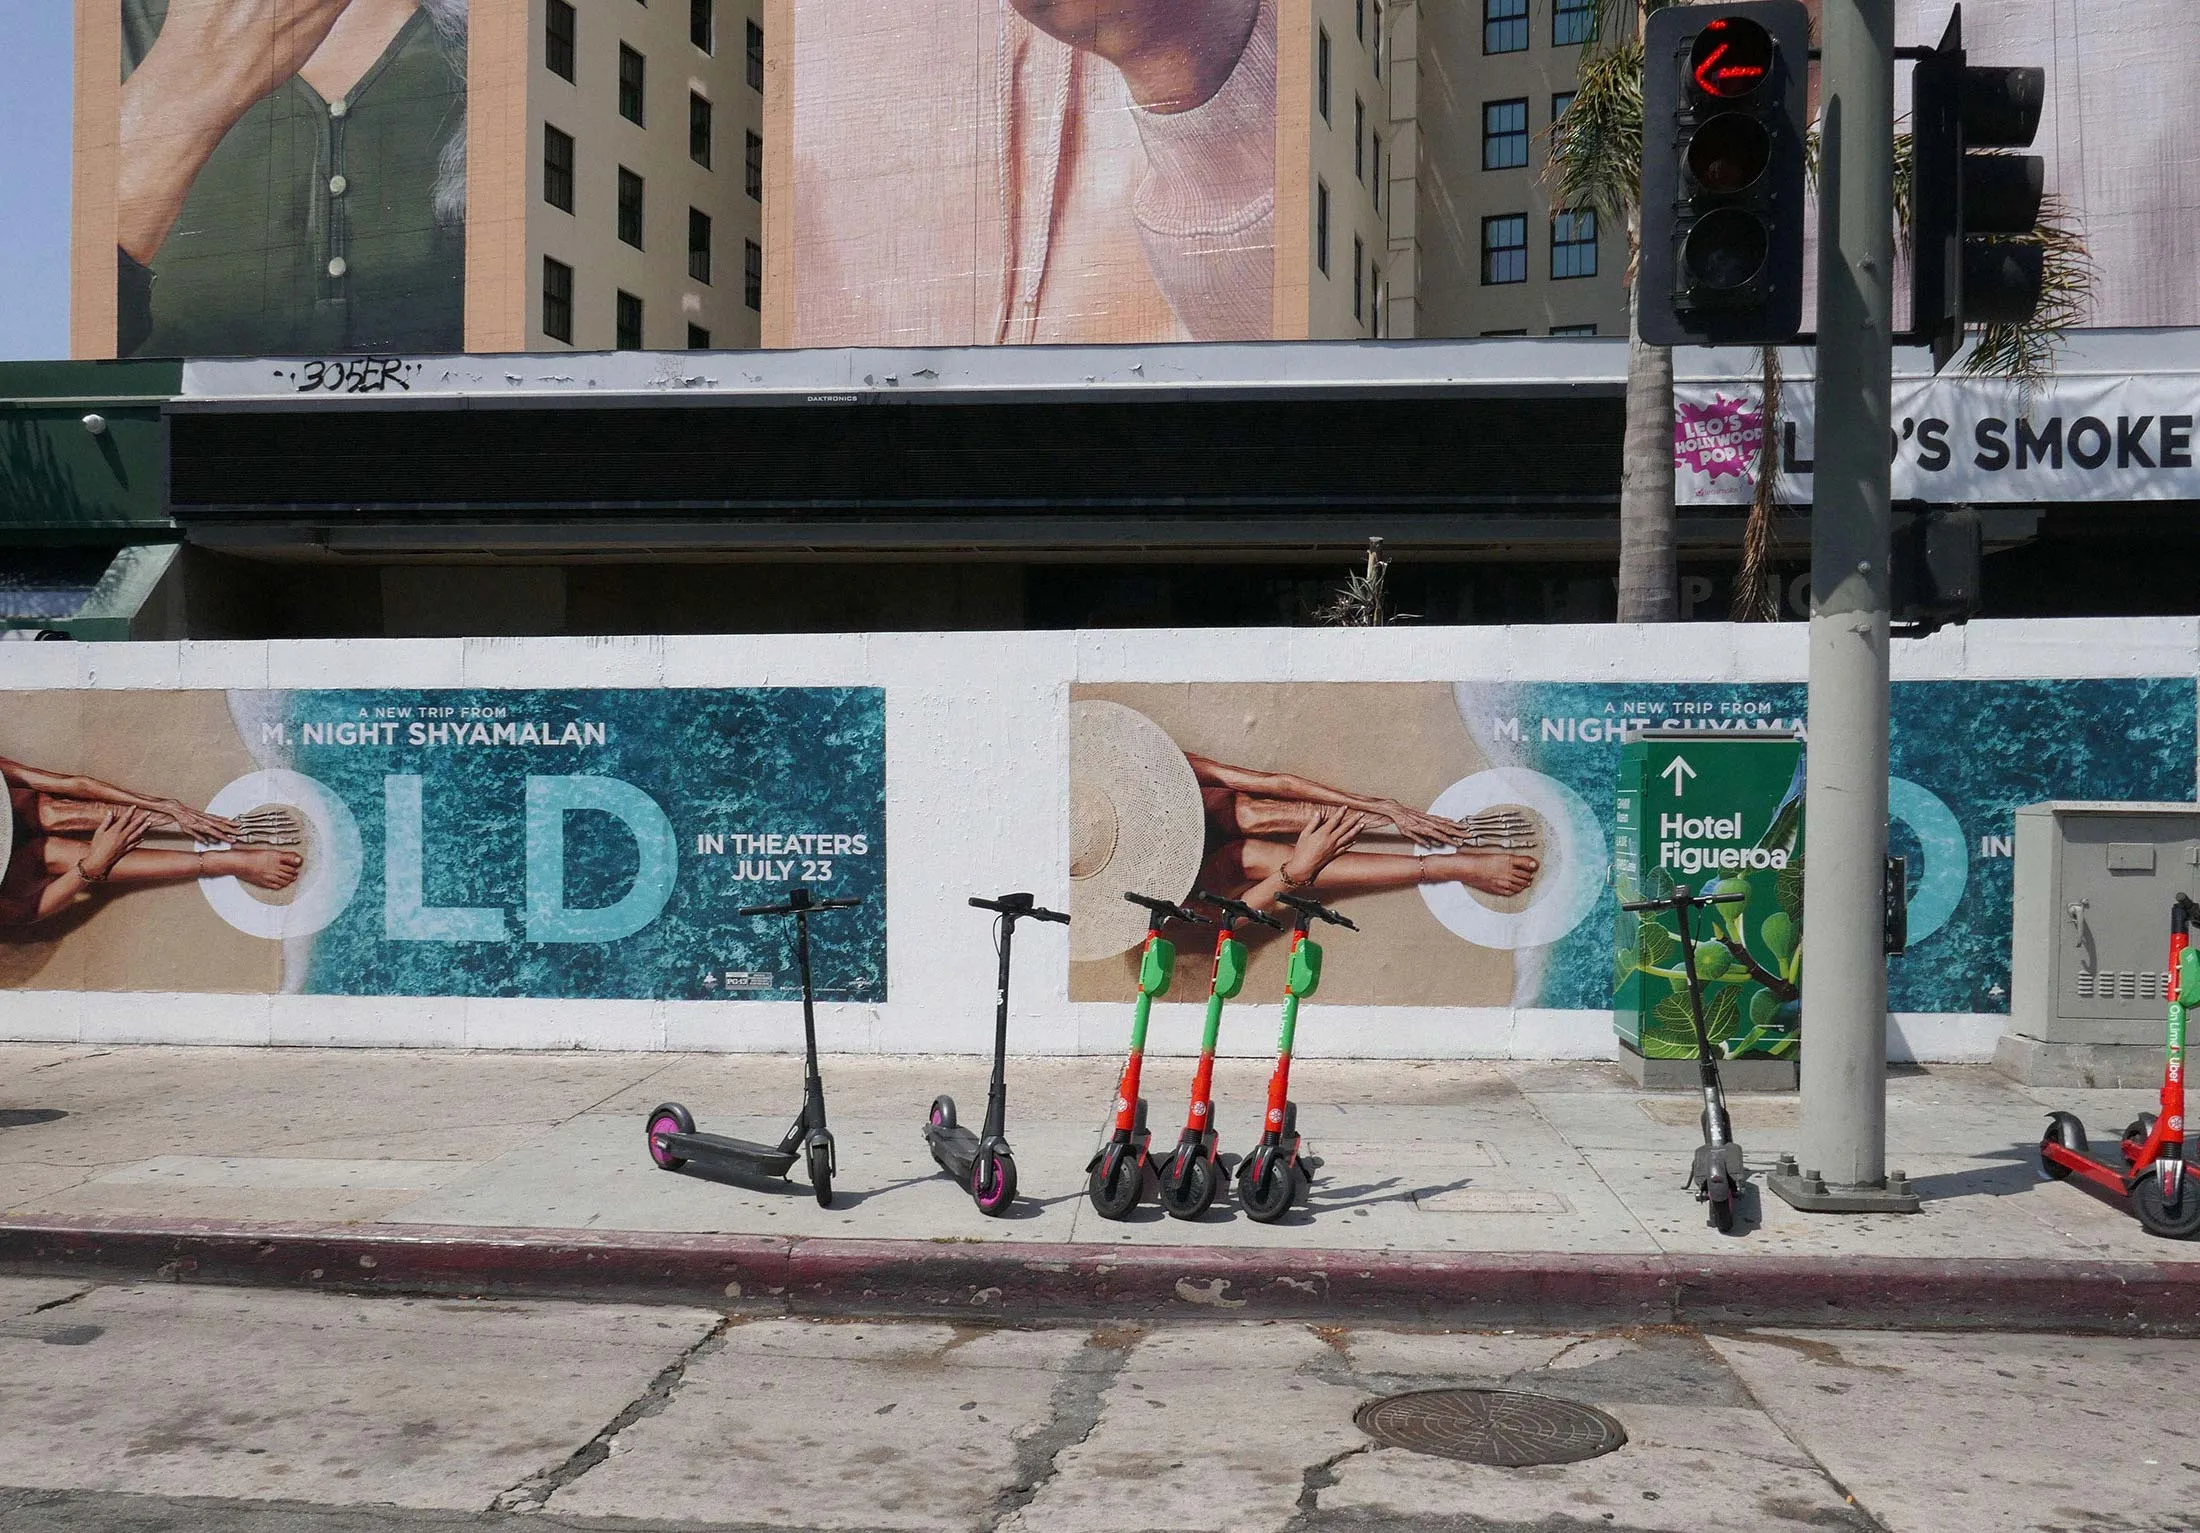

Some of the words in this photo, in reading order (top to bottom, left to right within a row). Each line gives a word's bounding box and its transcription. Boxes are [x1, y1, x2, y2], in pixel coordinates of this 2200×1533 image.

[1684, 415, 1742, 439] LEO'S
[1784, 418, 1951, 474] L'S
[1973, 415, 2193, 472] SMOKE
[359, 708, 369, 718] A
[376, 708, 412, 718] NEW
[418, 708, 454, 718] TRIP
[461, 707, 507, 718] FROM
[1604, 702, 1616, 714] A
[1624, 702, 1665, 714] NEW
[1672, 702, 1713, 714] TRIP
[1720, 702, 1771, 714] FROM
[262, 722, 293, 745] M.
[303, 722, 399, 746] NIGHT
[408, 722, 606, 746] SHYAMALAN
[1493, 718, 1529, 742] M.
[1660, 812, 1742, 840] Hotel
[198, 768, 679, 943] OLD
[697, 834, 724, 855] IN
[731, 834, 868, 855] THEATERS
[1981, 836, 2013, 857] IN
[1660, 841, 1787, 875] Figueroa
[732, 860, 794, 881] JULY
[801, 860, 833, 881] 23
[2169, 1004, 2180, 1021] On
[2168, 1057, 2181, 1083] Uber
